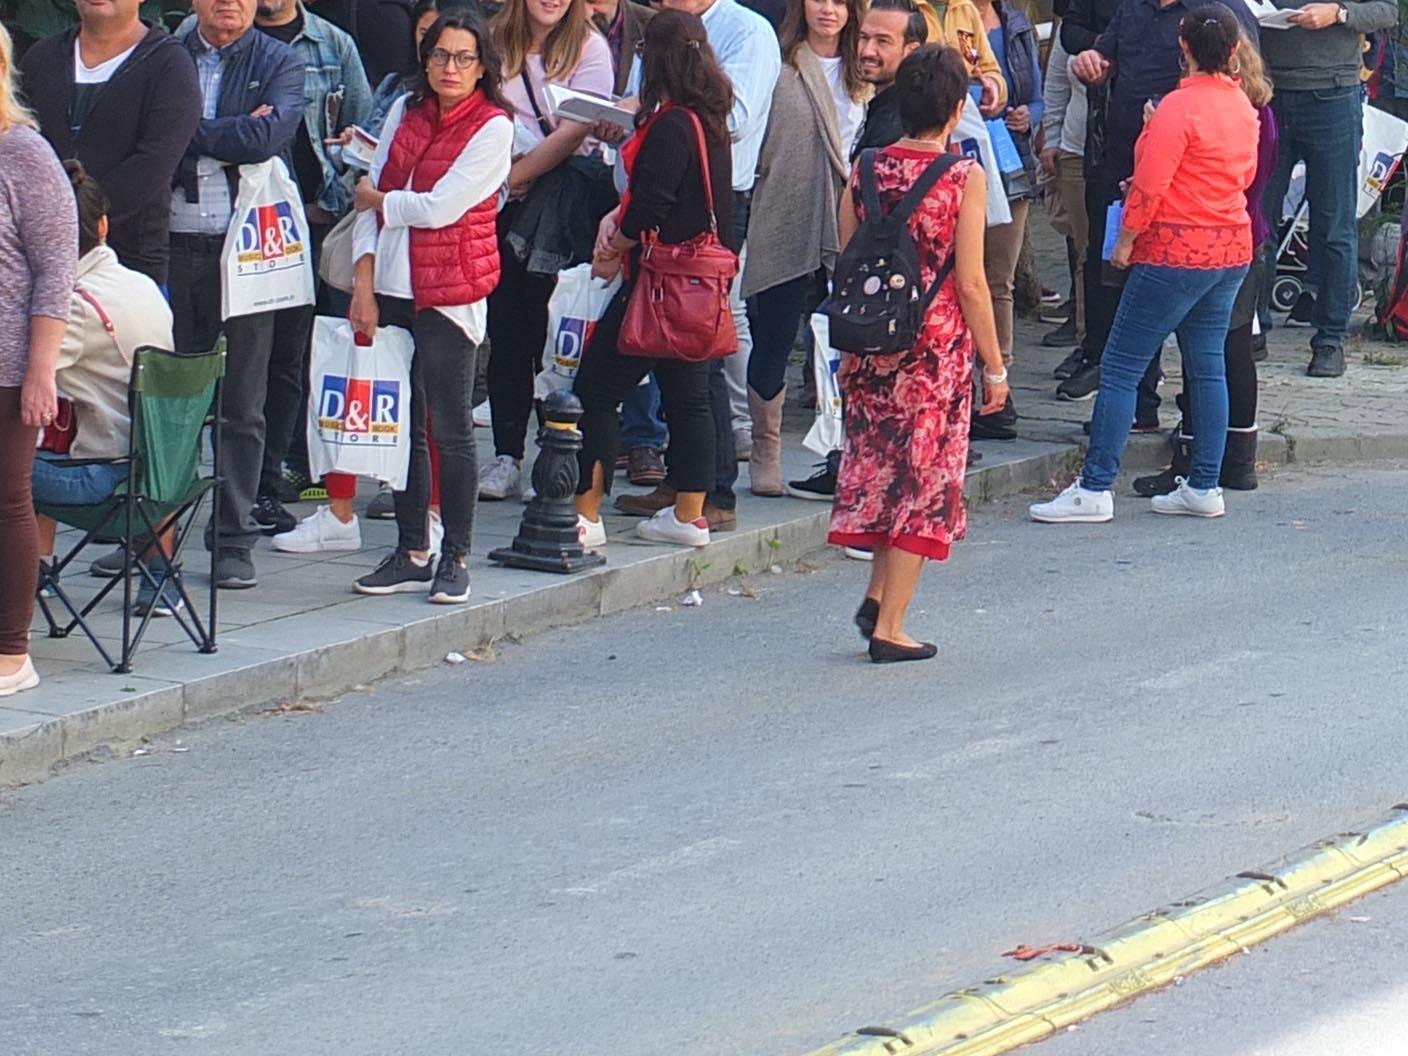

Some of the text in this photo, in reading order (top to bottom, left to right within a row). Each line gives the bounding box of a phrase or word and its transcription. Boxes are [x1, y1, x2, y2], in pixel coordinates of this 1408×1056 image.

[239, 216, 297, 257] D&R
[237, 254, 305, 273] STOE
[321, 390, 396, 430] D&R
